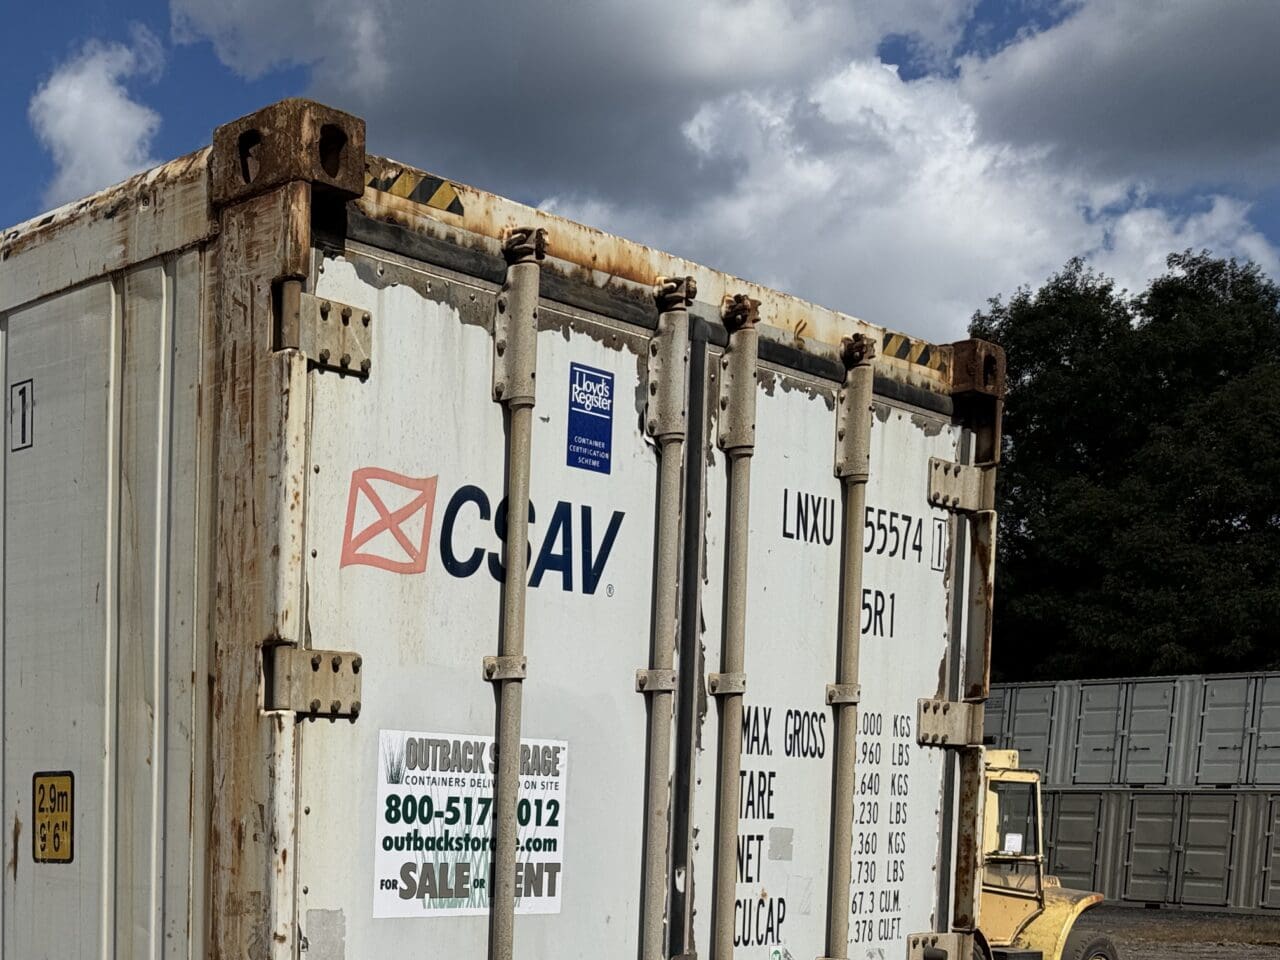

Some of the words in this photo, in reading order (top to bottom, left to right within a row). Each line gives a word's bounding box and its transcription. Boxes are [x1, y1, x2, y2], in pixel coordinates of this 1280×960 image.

[575, 371, 610, 398] Lloyd's
[571, 384, 612, 411] Register
[569, 444, 609, 460] CERTIFICATION
[574, 435, 606, 449] CONTAINER
[578, 456, 601, 468] SCHEME
[782, 488, 835, 546] LNXU
[864, 506, 923, 563] 55574
[861, 588, 895, 638] 5R1
[784, 708, 826, 760] GROSS
[893, 714, 911, 738] KGS
[405, 737, 486, 774] OUTBACK
[488, 742, 561, 777] SRAGE
[892, 743, 910, 766] LBS
[404, 775, 466, 788] CONTAINERS
[470, 778, 521, 789] DELIV
[524, 780, 537, 790] ON
[540, 781, 560, 791] SITE
[739, 770, 776, 819] TARE
[890, 773, 909, 796] KGS
[38, 784, 69, 813] 2.9m
[384, 794, 560, 827] 800-517-012
[889, 802, 907, 825] LBS
[888, 831, 906, 854] KGS
[736, 834, 764, 883] NET
[886, 860, 905, 882] LBS
[380, 878, 398, 891] FOR
[399, 861, 470, 900] SALE
[473, 878, 486, 889] OR
[851, 891, 875, 915] 67.3
